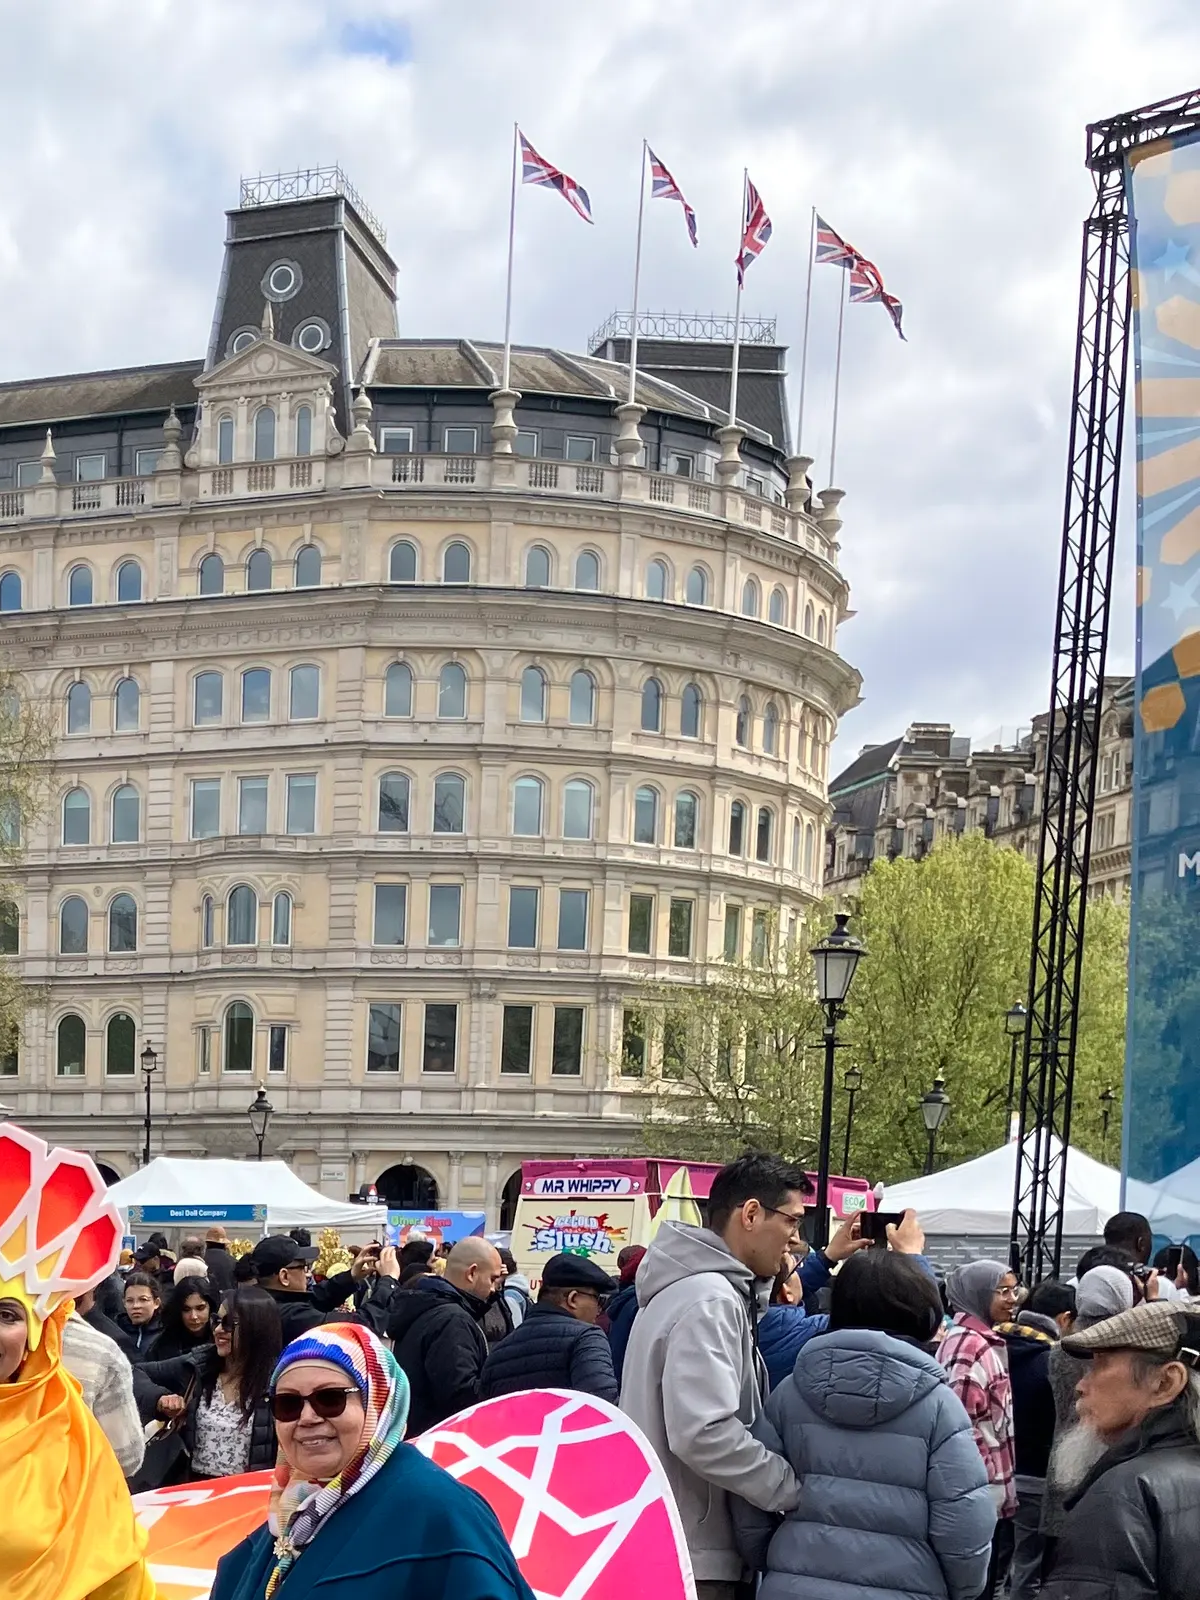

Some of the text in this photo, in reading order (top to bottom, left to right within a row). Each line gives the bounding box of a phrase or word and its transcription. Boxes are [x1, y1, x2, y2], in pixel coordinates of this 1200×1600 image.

[542, 1180, 622, 1193] MR WHIPPY
[844, 1196, 859, 1206] ECO
[199, 1209, 228, 1218] Company
[537, 1229, 611, 1254] Slush
